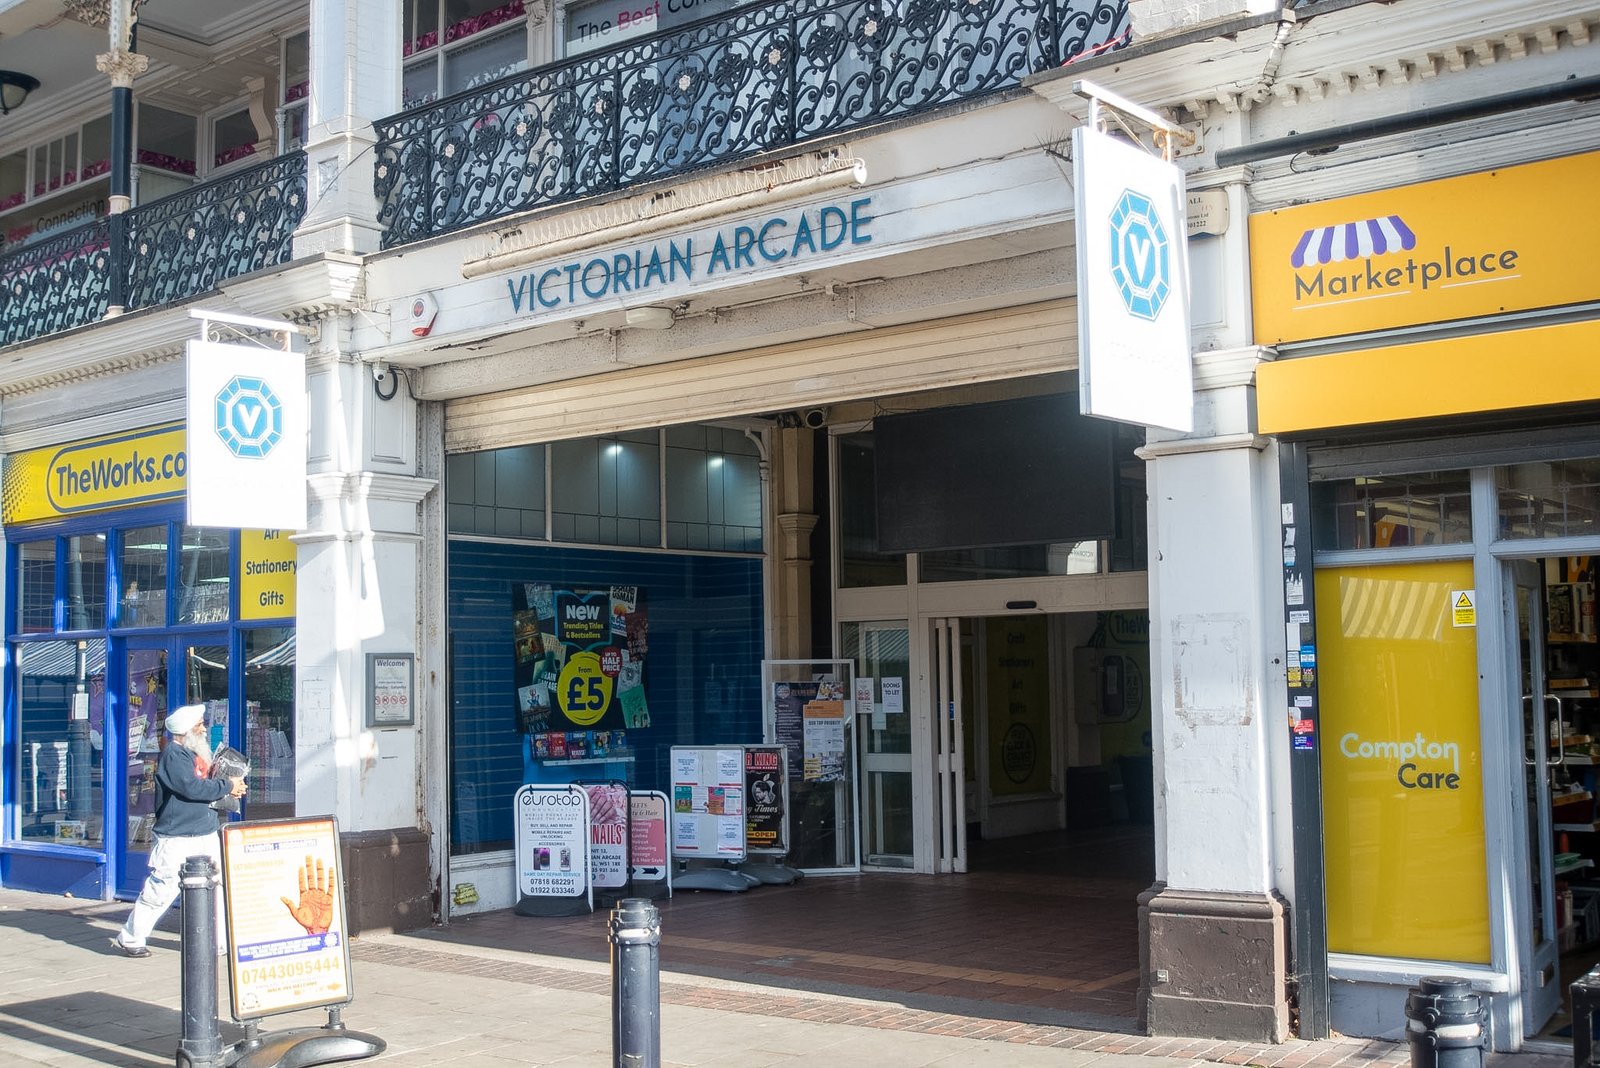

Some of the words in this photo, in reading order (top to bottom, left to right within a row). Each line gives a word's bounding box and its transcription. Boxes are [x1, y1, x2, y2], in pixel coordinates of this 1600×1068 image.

[577, 20, 612, 43] The
[617, 0, 660, 31] Best
[36, 199, 105, 233] Connection
[507, 238, 692, 314] VICTORIAN
[707, 198, 872, 274] ARCADE
[1294, 245, 1520, 301] Marketplace
[56, 450, 187, 497] TheWorks.co
[245, 559, 298, 578] Stationery
[259, 591, 285, 607] Gifts
[565, 604, 601, 620] New
[563, 622, 588, 631] Trending
[589, 622, 604, 630] Titles
[571, 631, 601, 639] Bestsellers
[602, 656, 621, 665] HALF
[602, 664, 621, 672] PRICE
[578, 666, 593, 674] From
[567, 676, 605, 711] £5
[882, 681, 901, 689] ROOMS
[754, 752, 778, 766] KING
[1340, 732, 1460, 772] Compton
[1397, 762, 1461, 790] Care
[522, 794, 581, 807] eurotop
[754, 804, 778, 813] Times
[592, 824, 622, 845] NAILS
[241, 955, 340, 985] 07443095444
